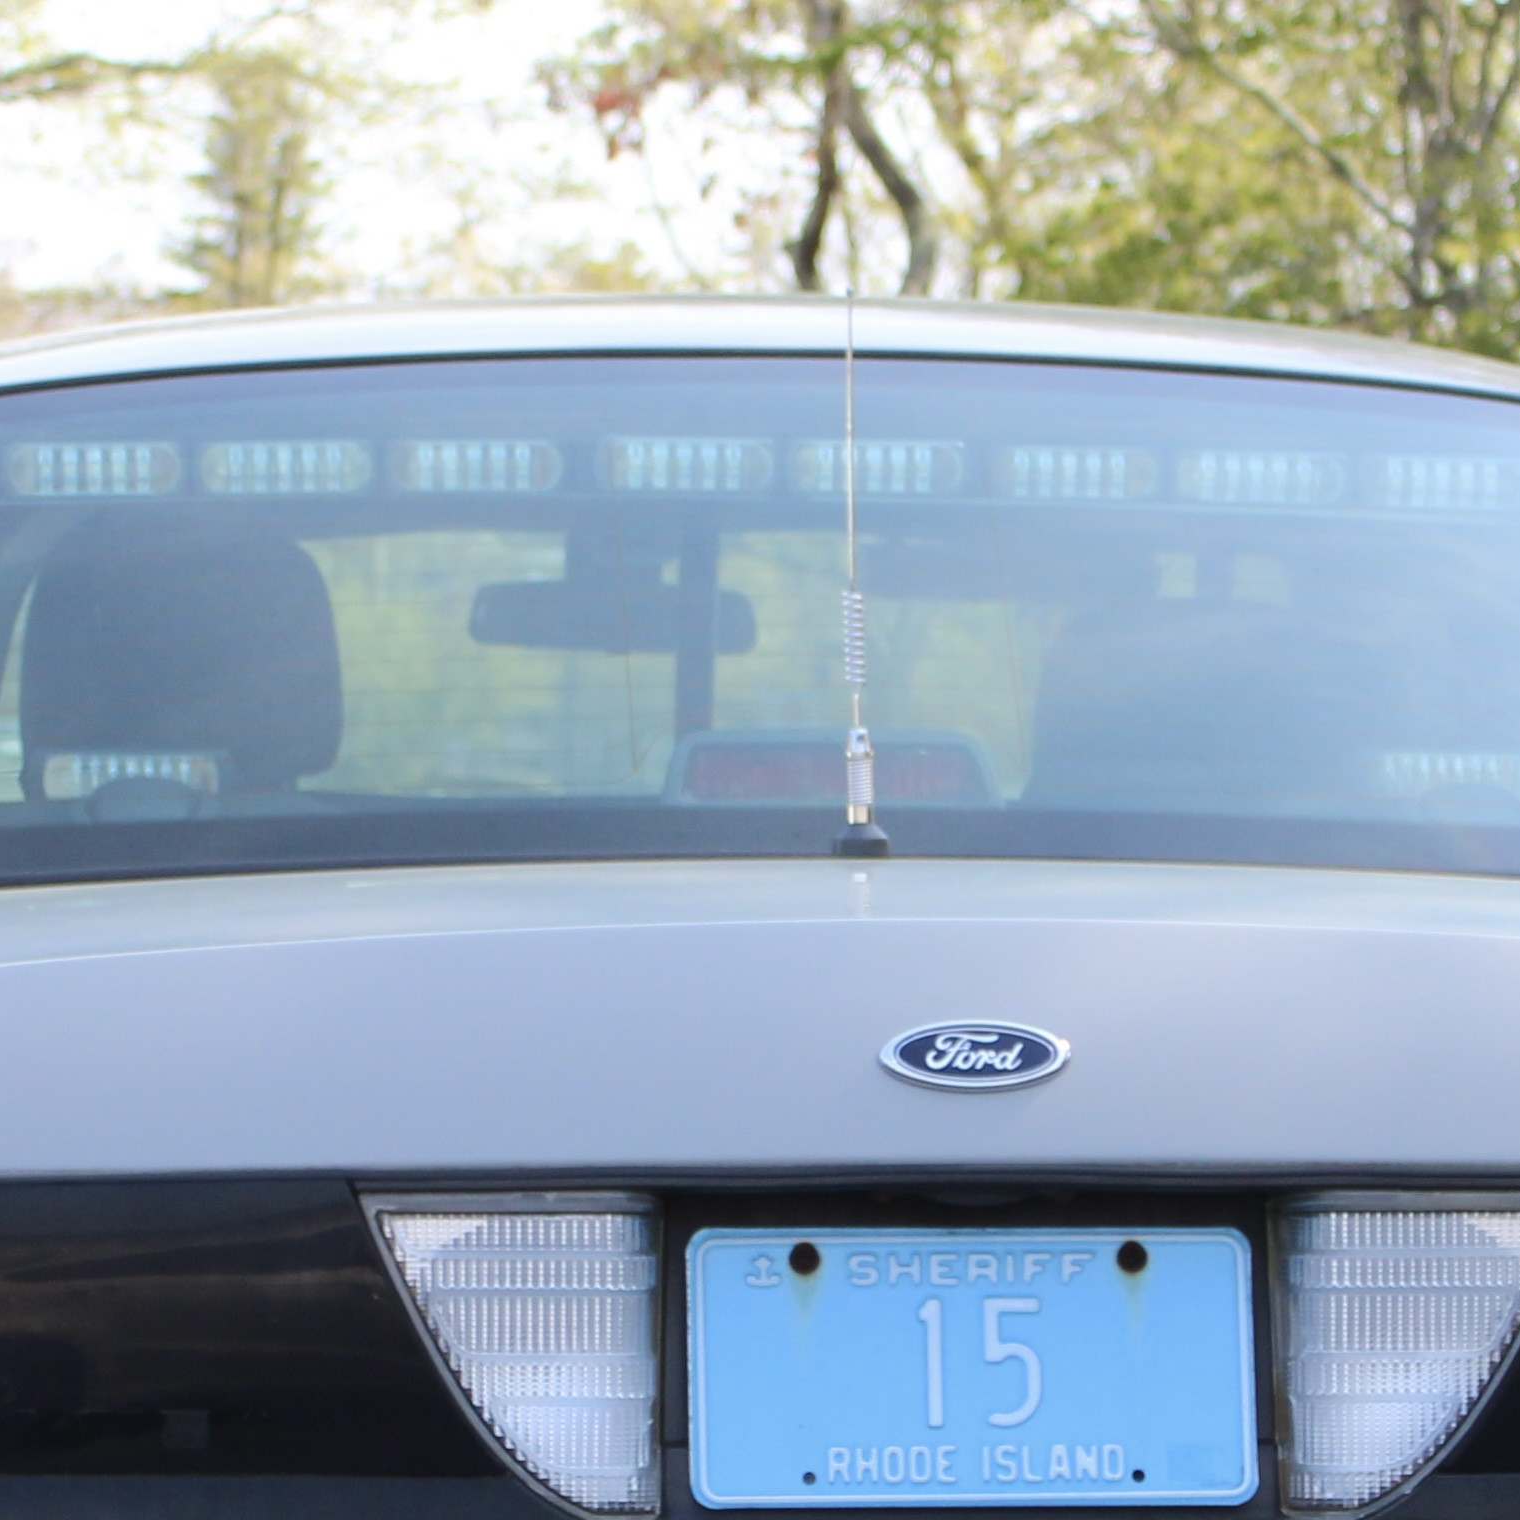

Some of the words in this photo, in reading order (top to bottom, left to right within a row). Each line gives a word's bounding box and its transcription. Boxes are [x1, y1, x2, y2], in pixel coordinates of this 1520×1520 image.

[925, 1032, 1025, 1071] Ford
[846, 1253, 1094, 1287] SHERIFF
[917, 1297, 1044, 1429] 15
[827, 1444, 958, 1486] RHODE
[982, 1442, 1126, 1484] ISLAND
